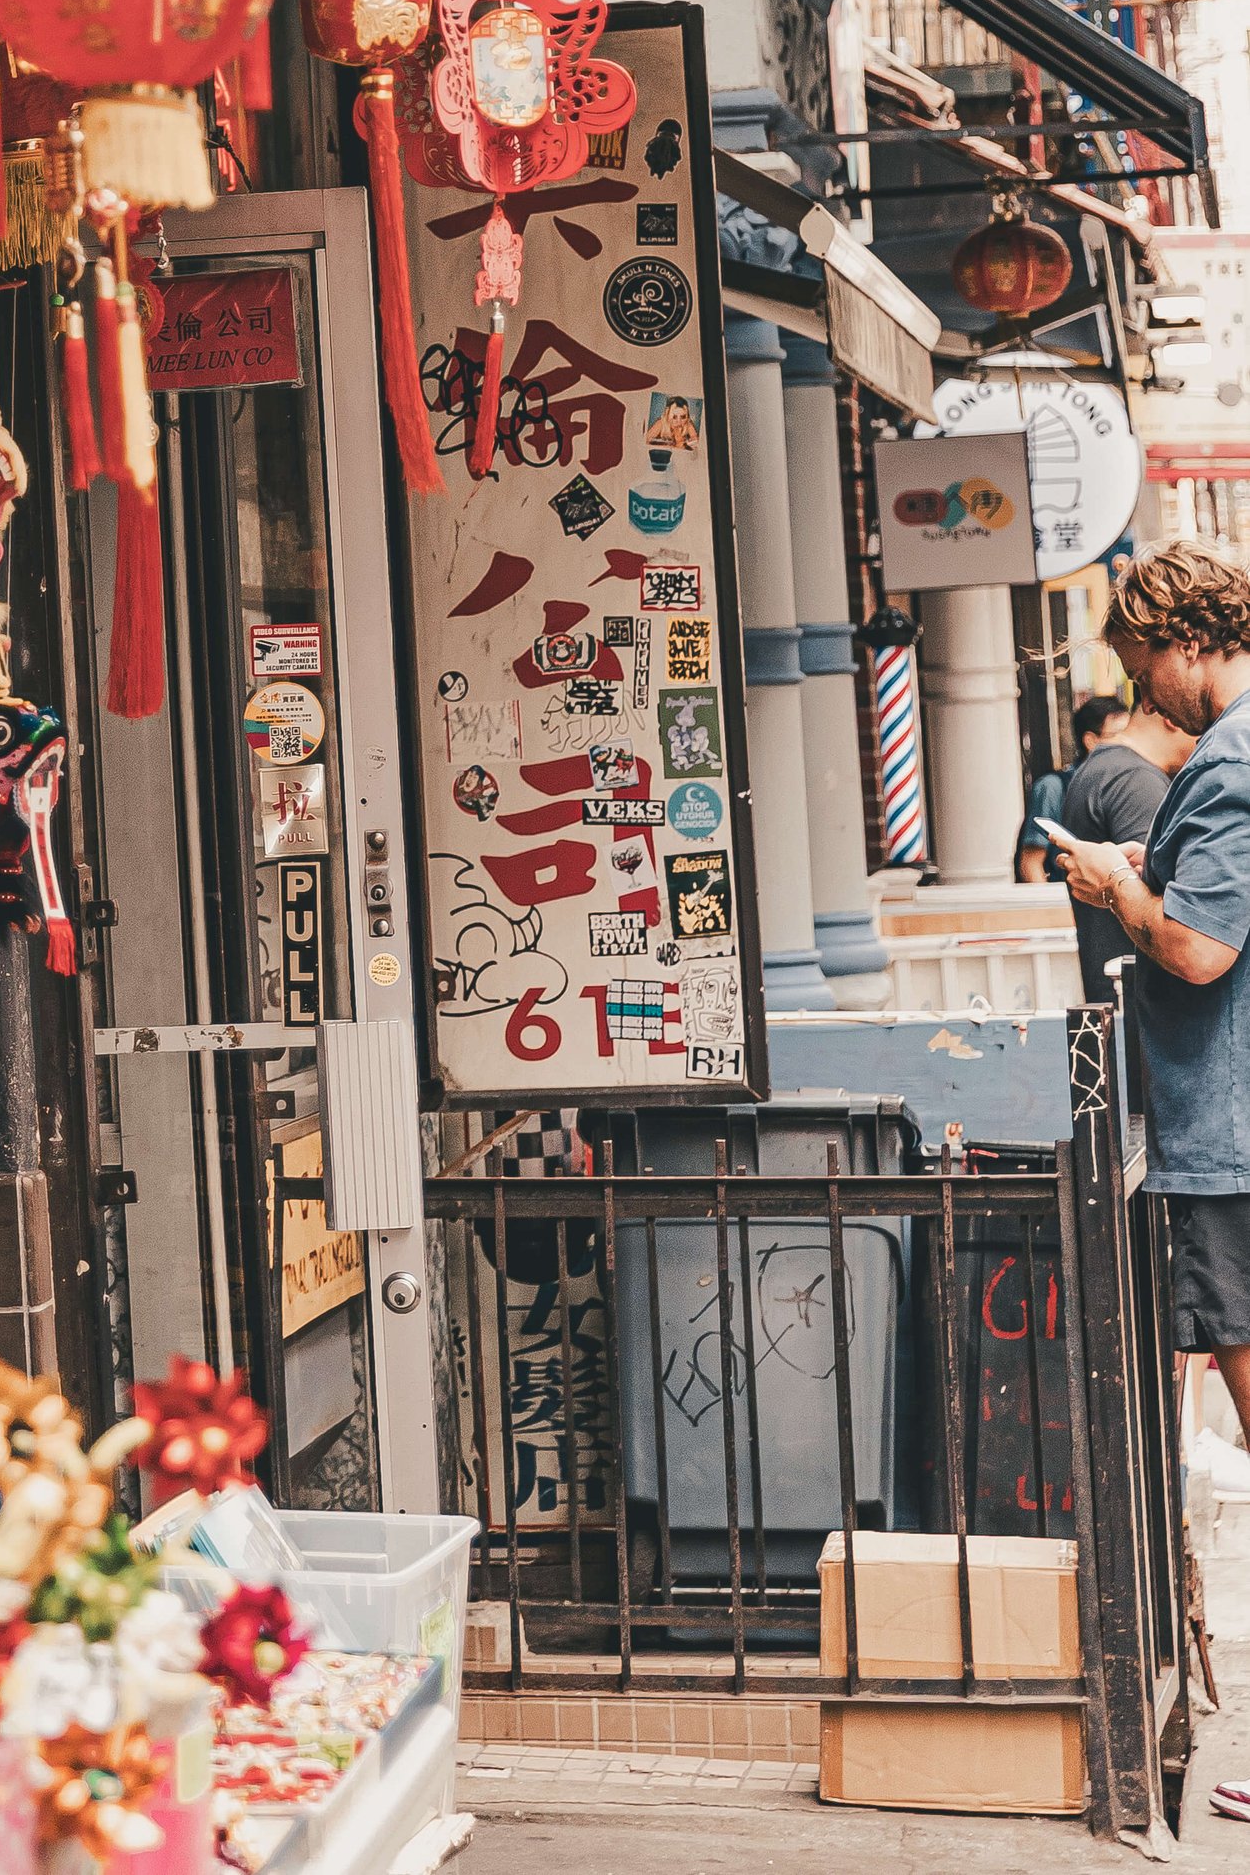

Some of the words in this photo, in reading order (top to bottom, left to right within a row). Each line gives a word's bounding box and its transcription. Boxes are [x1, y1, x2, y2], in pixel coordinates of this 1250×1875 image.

[146, 352, 191, 374] MEE
[193, 347, 239, 371] LUN
[242, 346, 274, 367] CO
[254, 628, 273, 636] VIDEO
[274, 627, 319, 635] SURVEILLANCE
[284, 640, 317, 648] WARNING
[272, 781, 318, 825] 拉
[584, 800, 664, 819] VEKS
[682, 801, 710, 812] STOP
[278, 831, 315, 844] PULL
[592, 928, 645, 945] FOWL
[286, 871, 316, 1022] PULL
